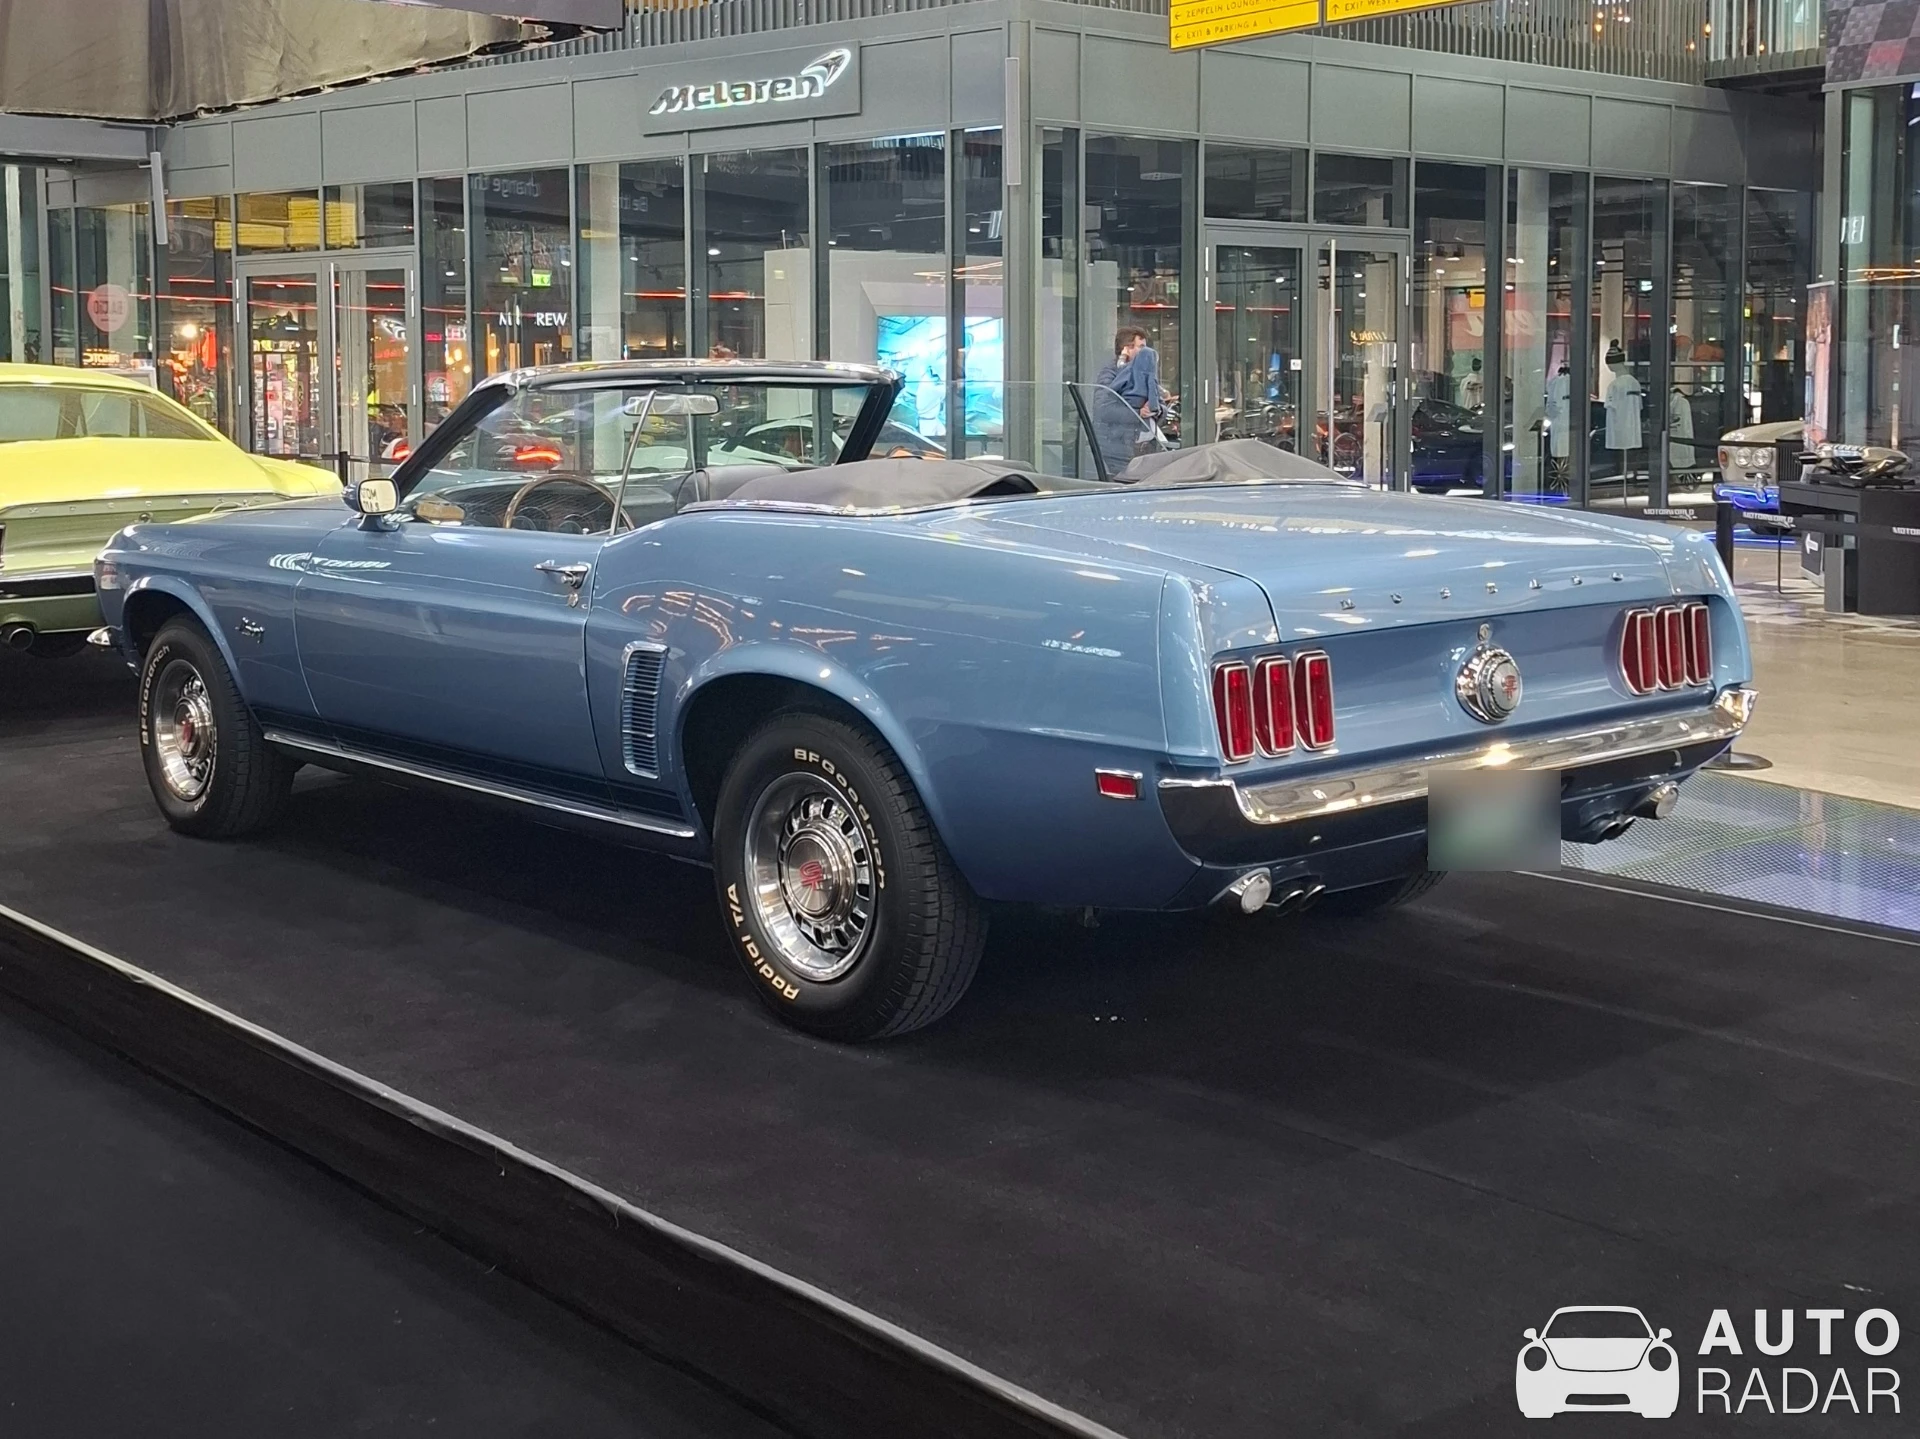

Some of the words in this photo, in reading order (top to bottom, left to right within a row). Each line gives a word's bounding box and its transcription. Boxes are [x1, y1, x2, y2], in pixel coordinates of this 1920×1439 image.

[1186, 6, 1223, 18] ZEPPELIN
[1345, 1, 1363, 11] EXIT
[1186, 28, 1203, 39] EXIT
[1214, 21, 1250, 34] PARKING
[649, 74, 825, 114] McLaren
[741, 934, 800, 1000] Radial
